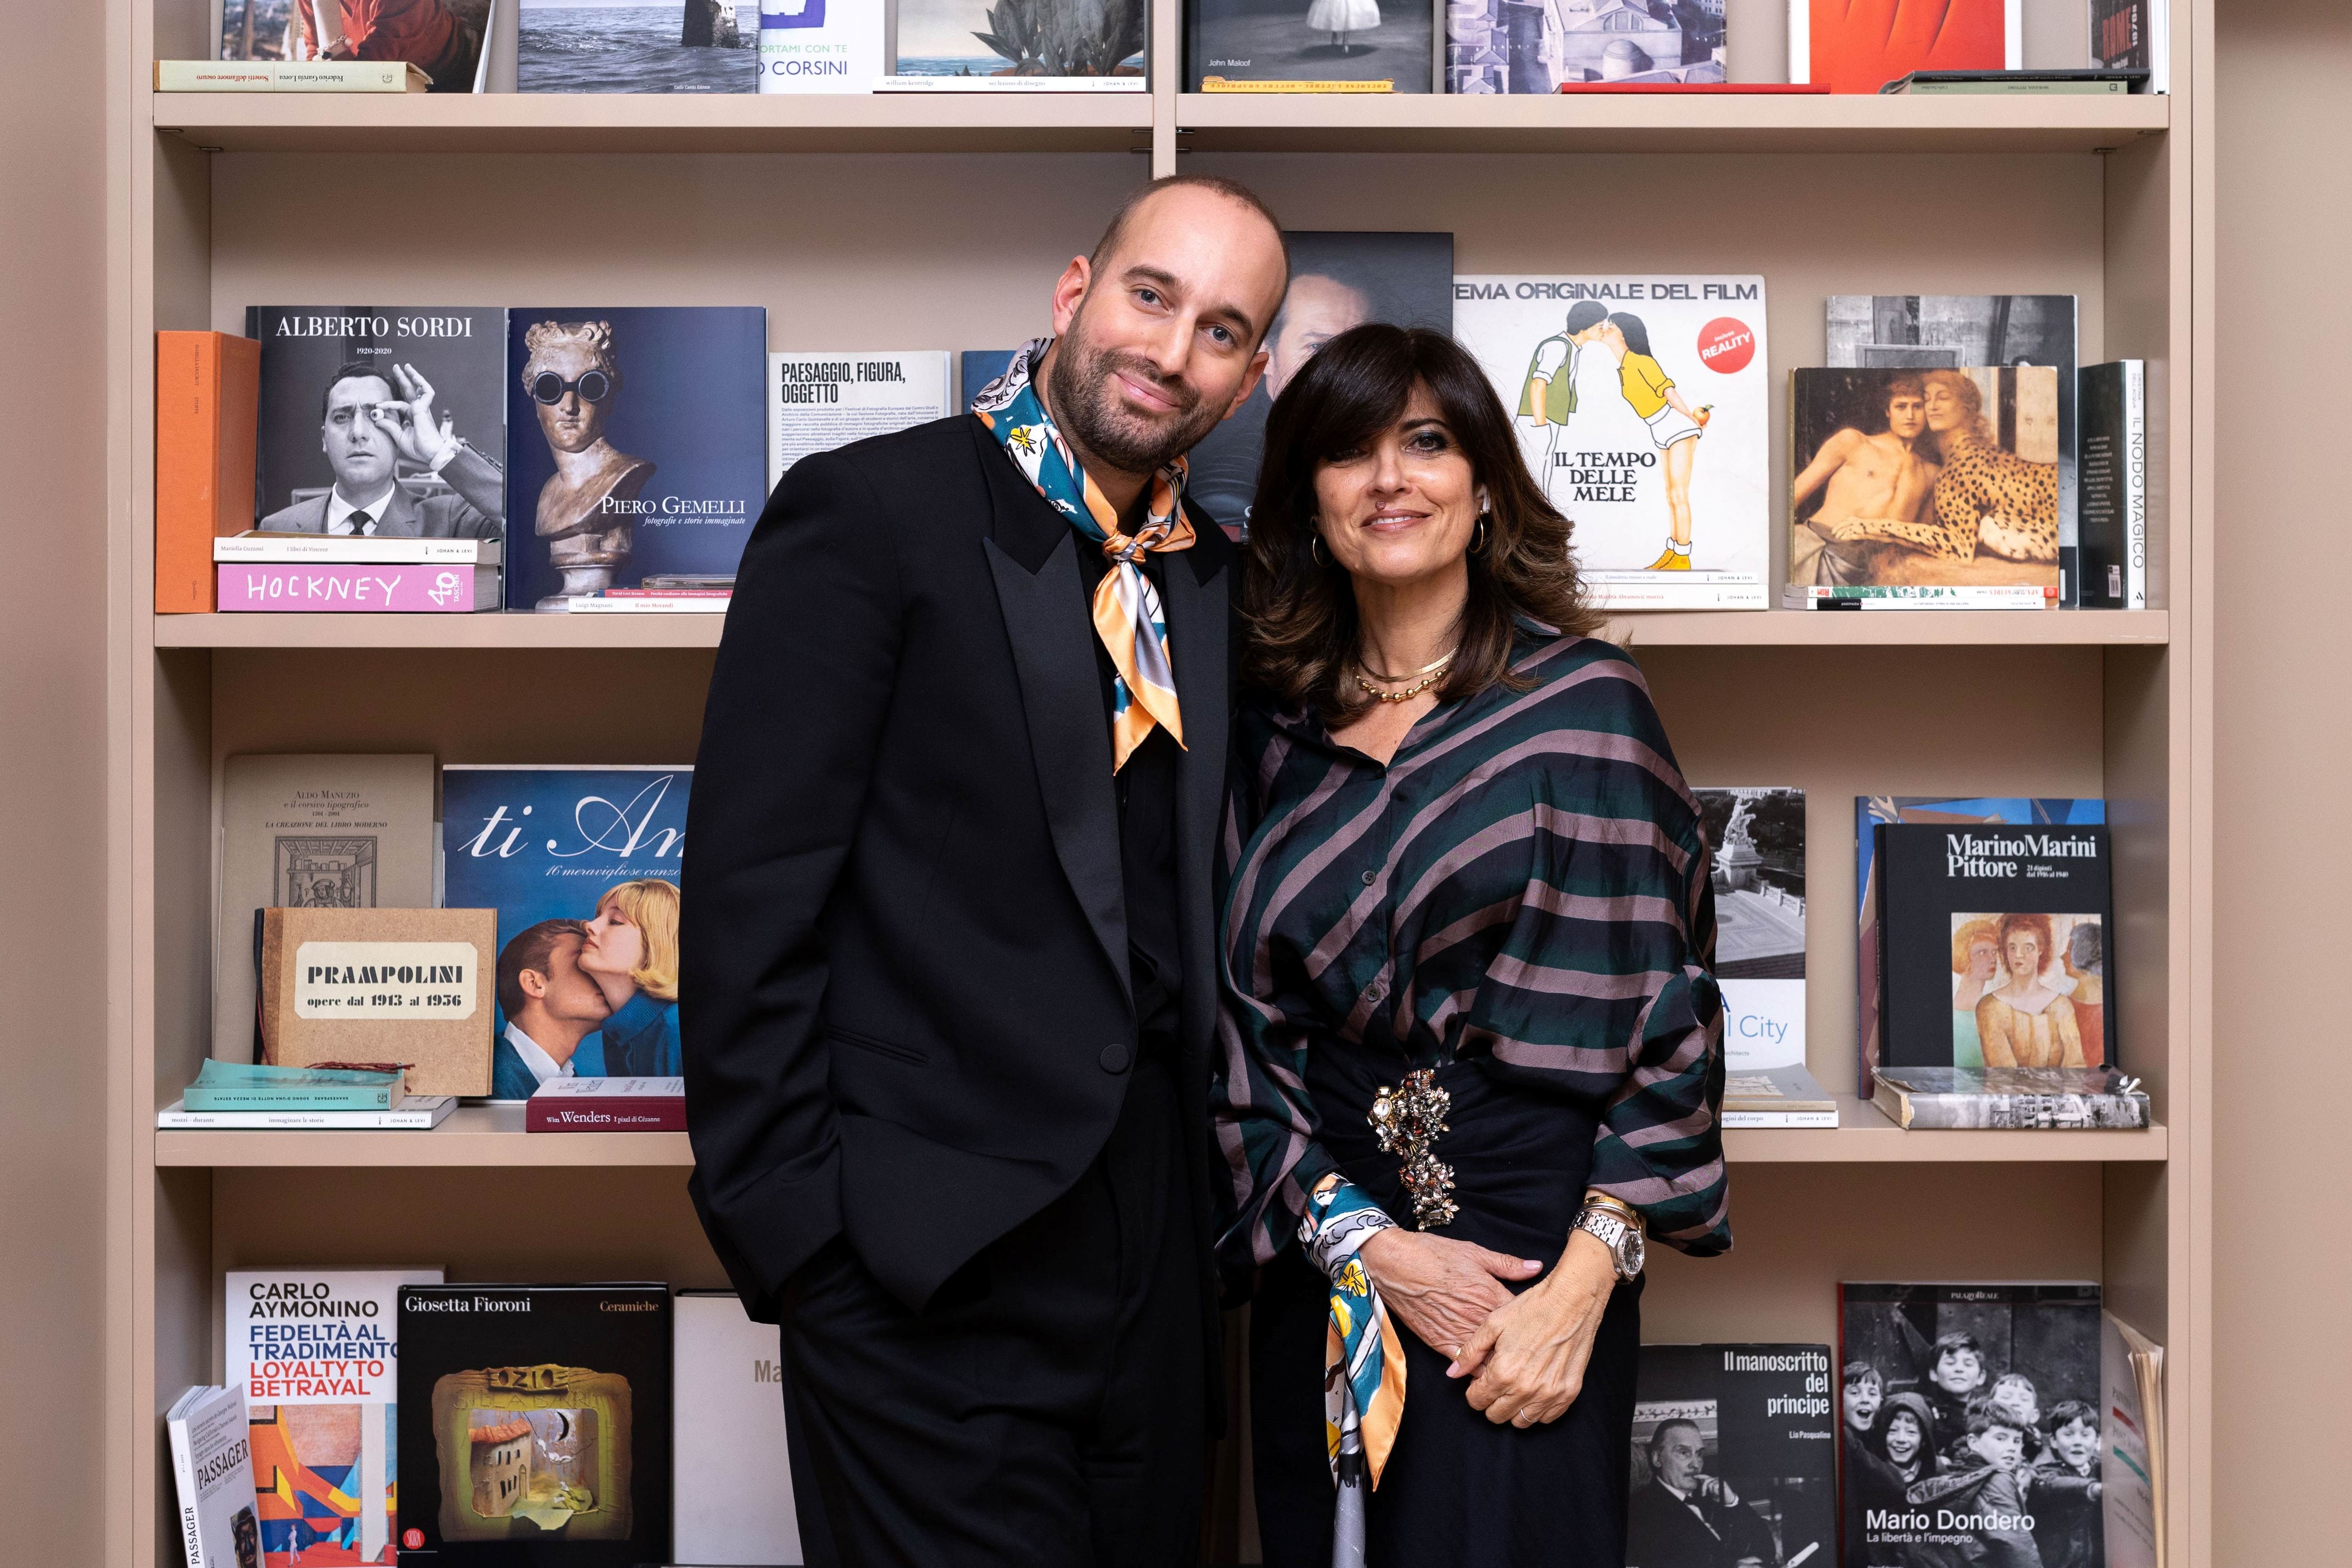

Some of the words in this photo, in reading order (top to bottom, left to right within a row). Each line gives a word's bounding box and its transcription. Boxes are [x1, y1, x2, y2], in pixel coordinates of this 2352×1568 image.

[772, 61, 847, 75] CORSINI
[1452, 283, 1510, 300] EMA
[1515, 282, 1644, 300] ORIGINALE
[1651, 283, 1698, 300] DEL
[1703, 283, 1758, 300] FILM
[276, 316, 388, 337] ALBERTO
[397, 317, 472, 338] SORDI
[1702, 333, 1751, 360] REALITY
[782, 362, 854, 385] PAESAGGIO,
[857, 362, 906, 384] FIGURA,
[782, 383, 838, 404] OGGETTO
[2134, 417, 2141, 428] IL
[1554, 453, 1573, 468] IL
[1575, 453, 1656, 468] TEMPO
[2132, 433, 2143, 488] NODO
[1570, 470, 1637, 485] DELLE
[1573, 487, 1636, 502] MELE
[600, 496, 657, 514] PIERO
[661, 496, 746, 514] GEMELLI
[643, 516, 676, 527] fotografie
[684, 516, 703, 525] storie
[705, 516, 746, 527] immaginate
[2133, 495, 2144, 568] MAGICO
[247, 573, 401, 606] HOCKNEY
[427, 572, 456, 606] 40
[295, 790, 318, 799] ALDO
[321, 790, 359, 799] MANUZIO
[327, 801, 369, 810] tipografico
[457, 805, 533, 859] ti
[561, 861, 642, 881] meravigliose
[644, 868, 681, 876] canzo
[1947, 854, 2017, 878] Pittore
[308, 965, 462, 984] PRAMPOLINI
[307, 996, 342, 1008] opere
[347, 995, 364, 1006] dal
[371, 994, 403, 1007] 1913
[409, 995, 420, 1006] al
[426, 995, 461, 1007] 1956
[1740, 1015, 1788, 1043] City
[561, 1111, 611, 1122] Wenders
[249, 1282, 330, 1300] CARLO
[249, 1300, 379, 1318] AYMONINO
[405, 1296, 469, 1313] Giosetta
[473, 1296, 531, 1313] Fioroni
[600, 1300, 659, 1313] Ceramiche
[250, 1320, 352, 1342] FEDELTÀ
[356, 1324, 385, 1341] AL
[250, 1361, 349, 1378] LOYALTY
[355, 1360, 384, 1377] TO
[1724, 1351, 1734, 1371] Il
[1736, 1352, 1828, 1372] manoscritto
[250, 1379, 371, 1397] BETRAYAL
[497, 1369, 555, 1390] OZIO
[1805, 1373, 1828, 1393] del
[1768, 1394, 1829, 1417] principe
[198, 1439, 249, 1490] PASSAGER
[1867, 1509, 1930, 1530] Mario
[1937, 1509, 2035, 1530] Dondero
[185, 1506, 200, 1564] PASSAGER
[1867, 1533, 1879, 1543] La
[1882, 1533, 1913, 1543] libertà
[1924, 1533, 1973, 1545] l'impegno
